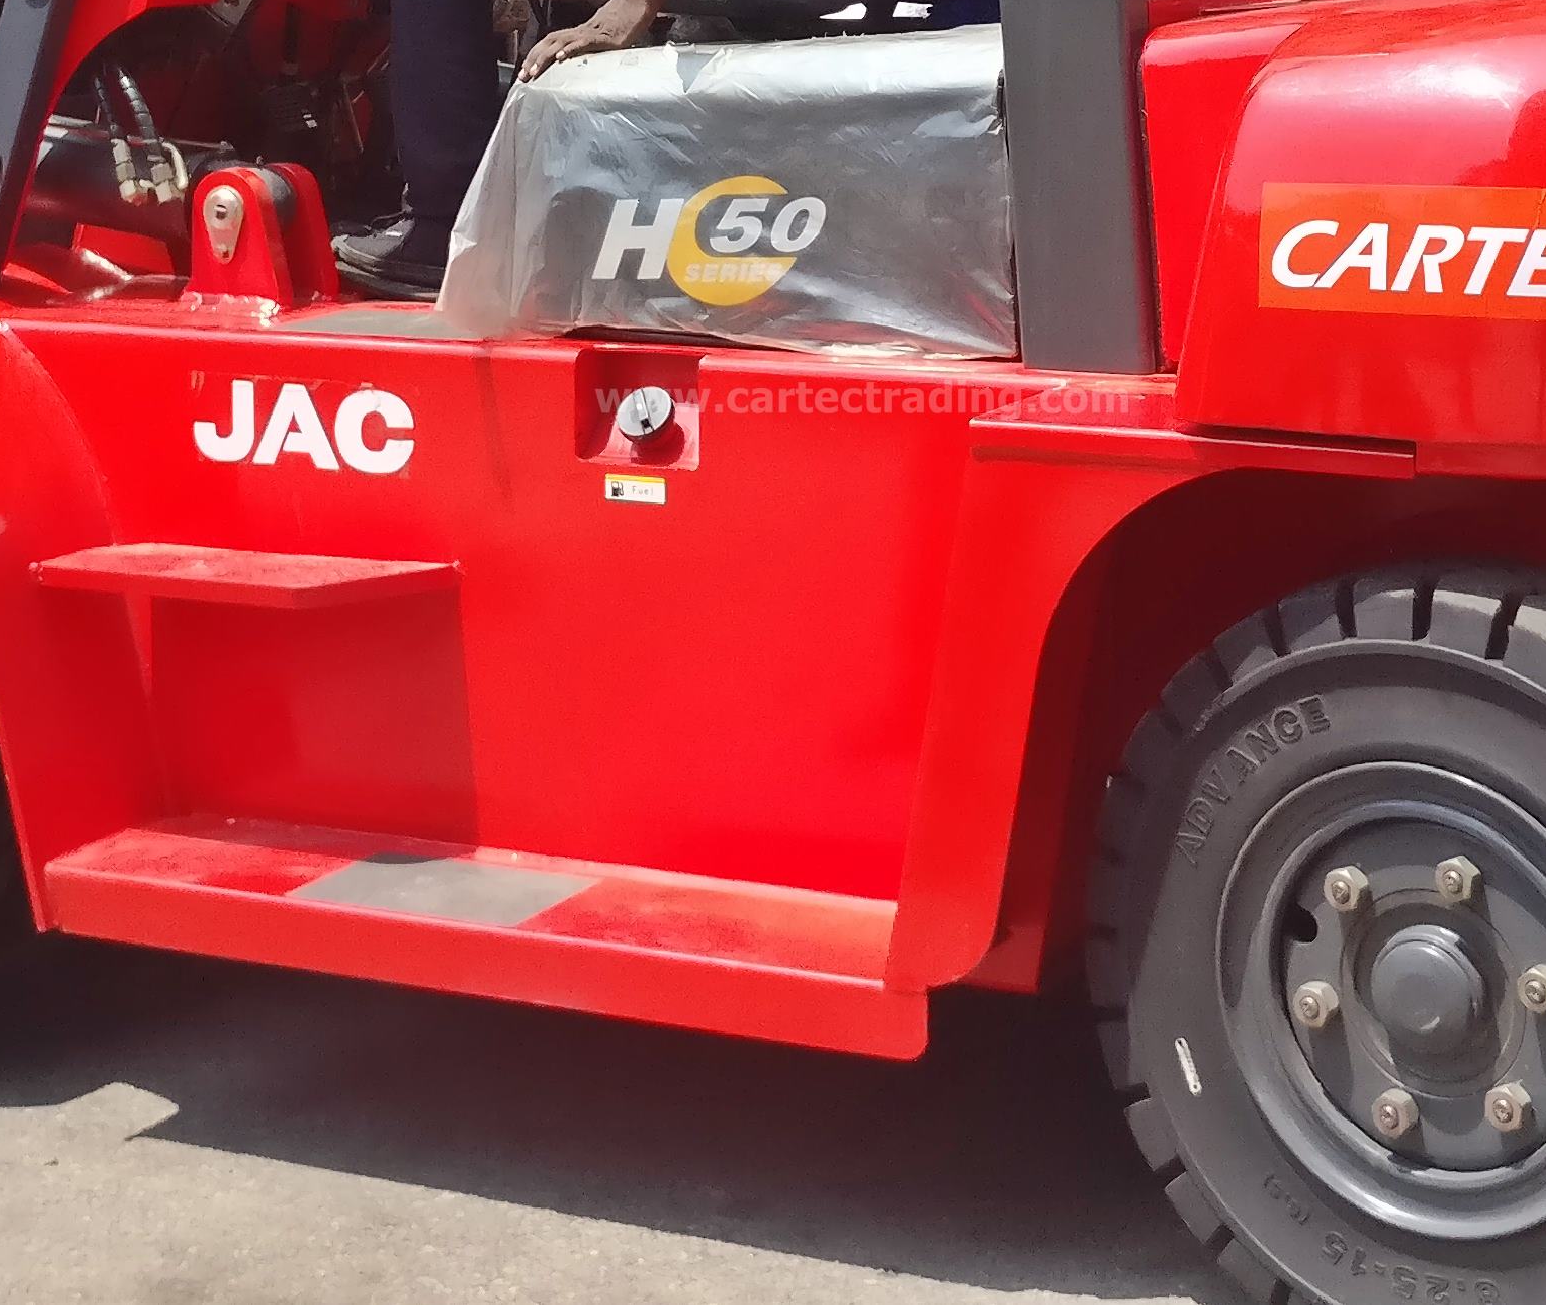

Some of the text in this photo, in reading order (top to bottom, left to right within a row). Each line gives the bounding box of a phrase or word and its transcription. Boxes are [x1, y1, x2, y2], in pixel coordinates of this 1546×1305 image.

[709, 196, 827, 254] 50
[684, 261, 783, 283] SERIES
[193, 379, 416, 474] JAC
[631, 485, 654, 496] Fuel
[1175, 695, 1331, 868] ADVANCE
